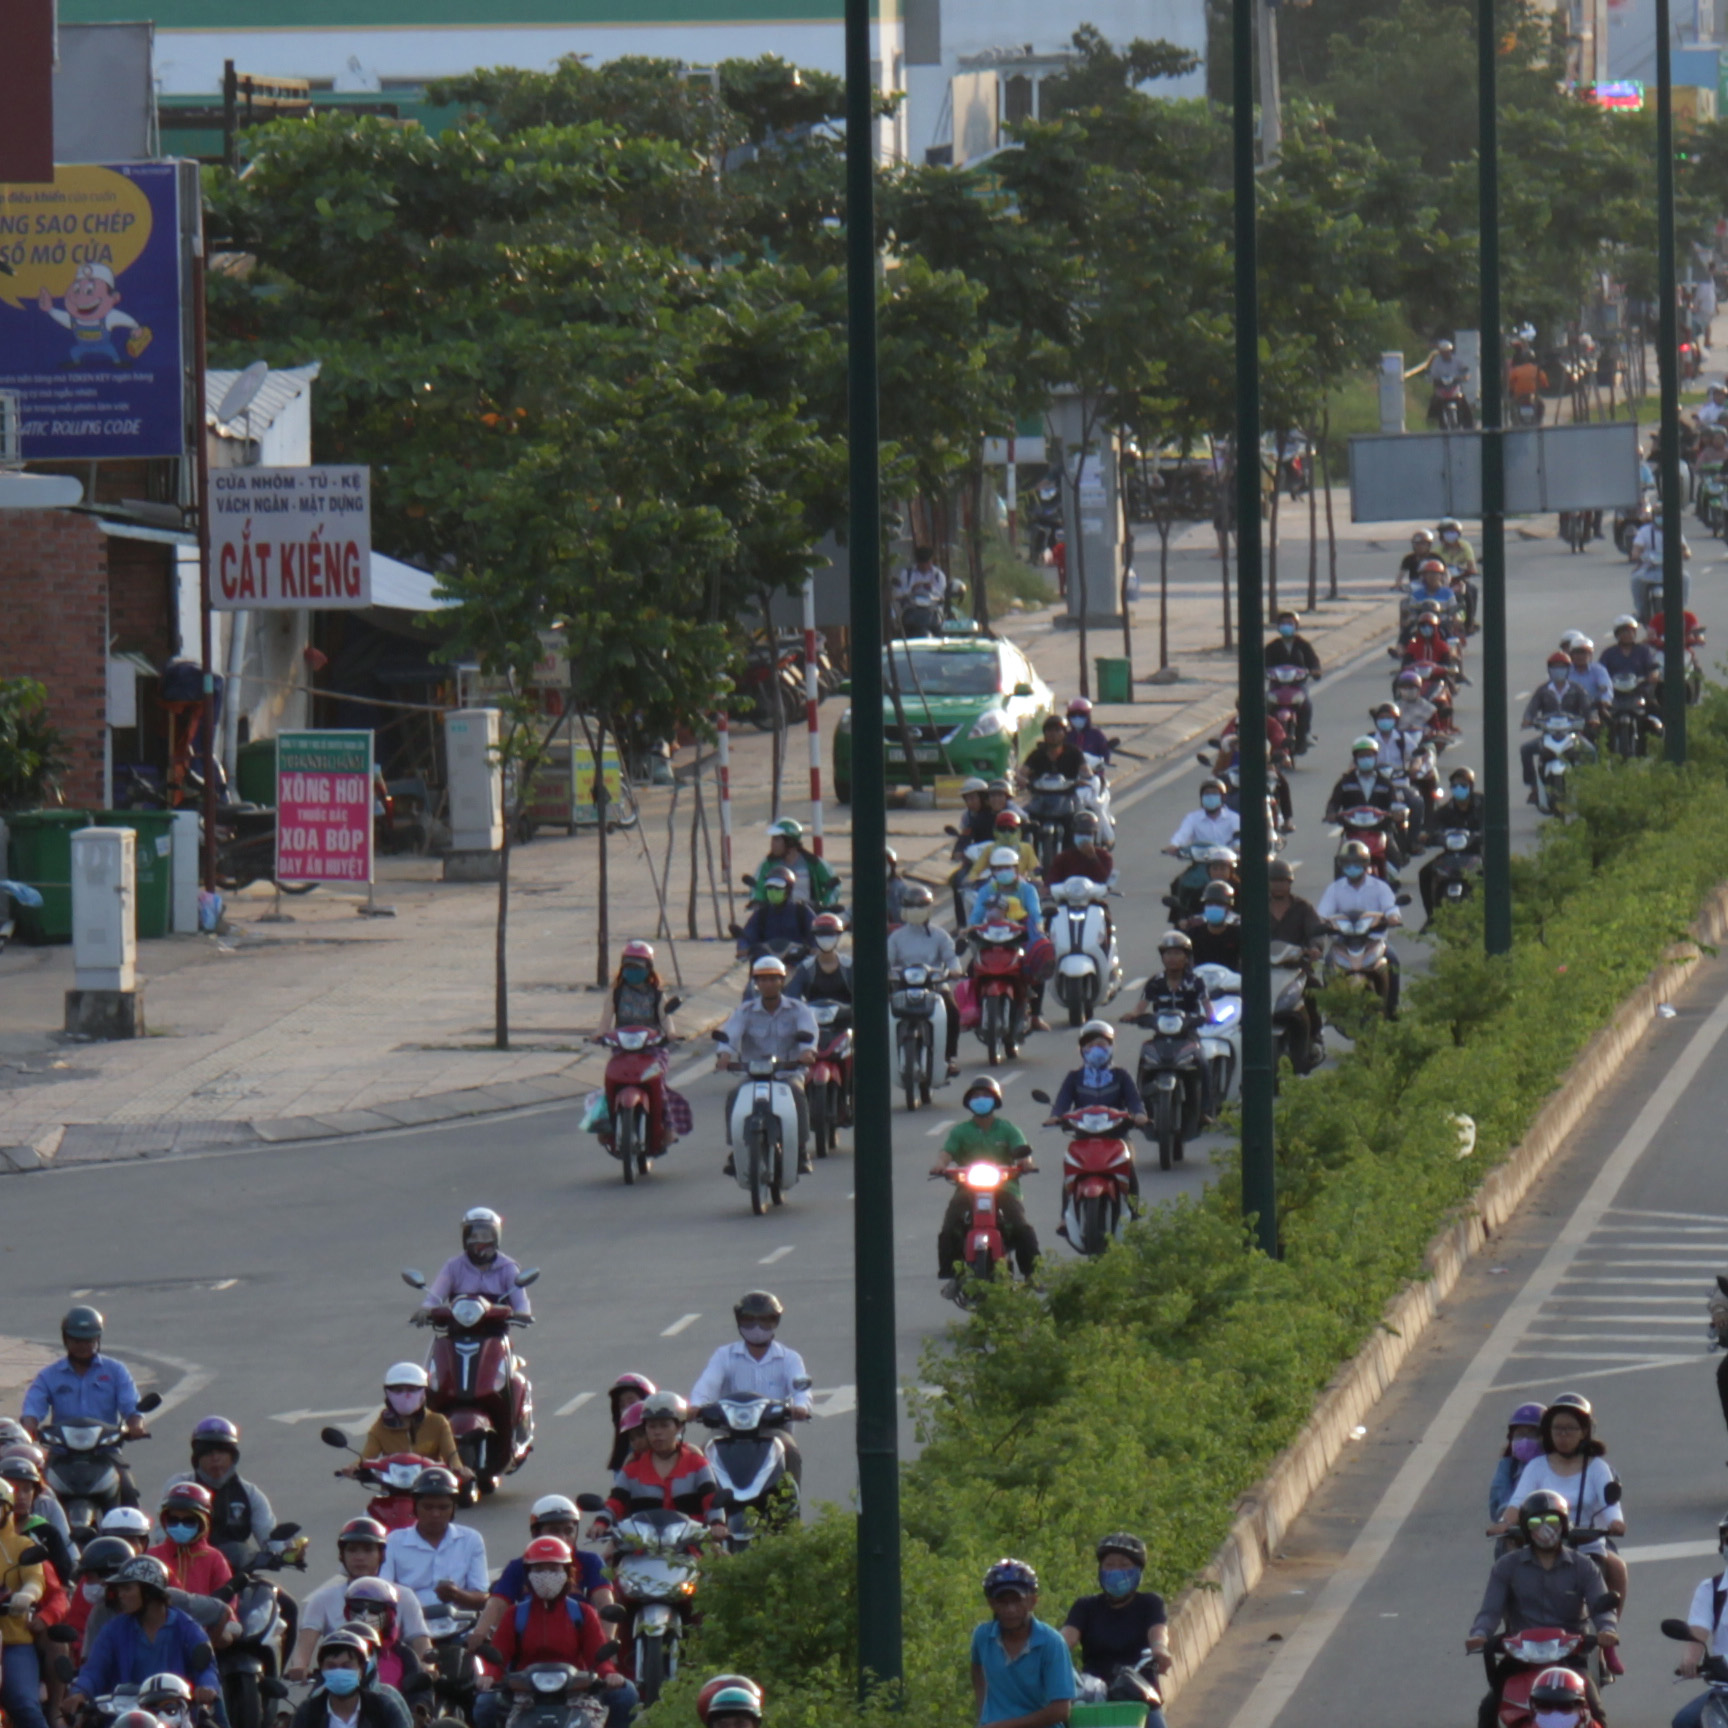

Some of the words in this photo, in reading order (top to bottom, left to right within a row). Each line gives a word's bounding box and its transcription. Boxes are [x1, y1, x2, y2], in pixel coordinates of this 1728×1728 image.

[35, 213, 78, 235] SAO
[83, 209, 136, 234] CHÉP
[220, 518, 271, 600] CẮT
[280, 523, 361, 599] KIẾNG
[281, 774, 330, 804] XÔNG
[281, 827, 319, 851] XOA
[326, 824, 364, 851] BÓP
